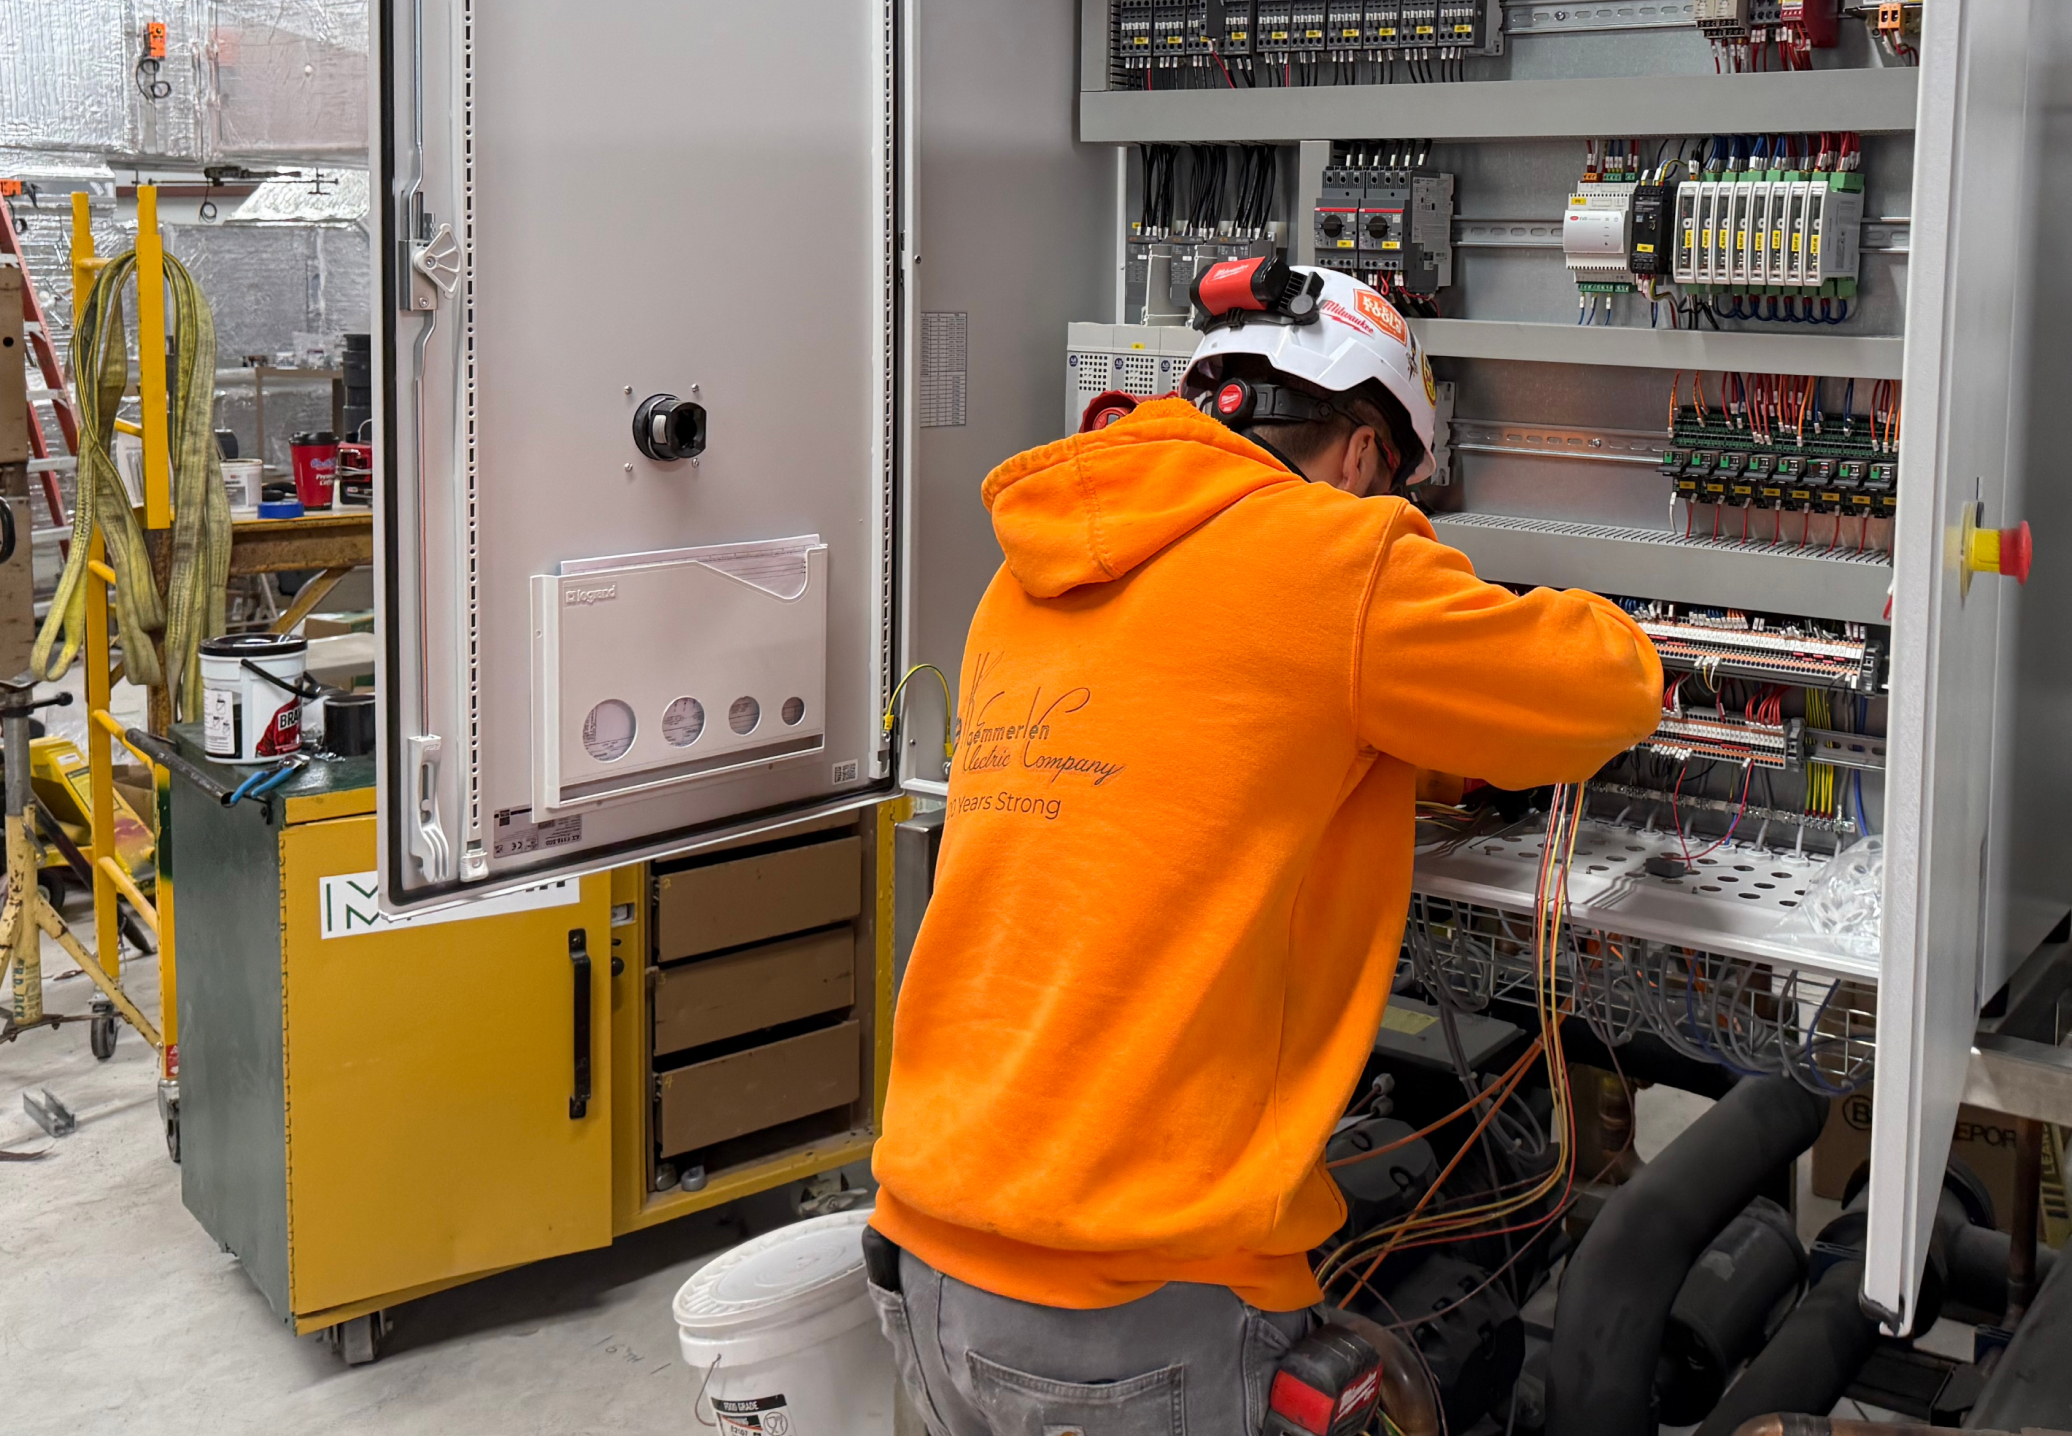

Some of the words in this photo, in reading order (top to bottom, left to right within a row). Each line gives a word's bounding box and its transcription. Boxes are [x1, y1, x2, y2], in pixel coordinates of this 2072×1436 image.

[1321, 299, 1375, 334] Milwaukee
[1023, 740, 1126, 786] Company
[958, 794, 993, 815] Years
[995, 791, 1061, 820] Strong
[738, 1400, 760, 1412] GRADE
